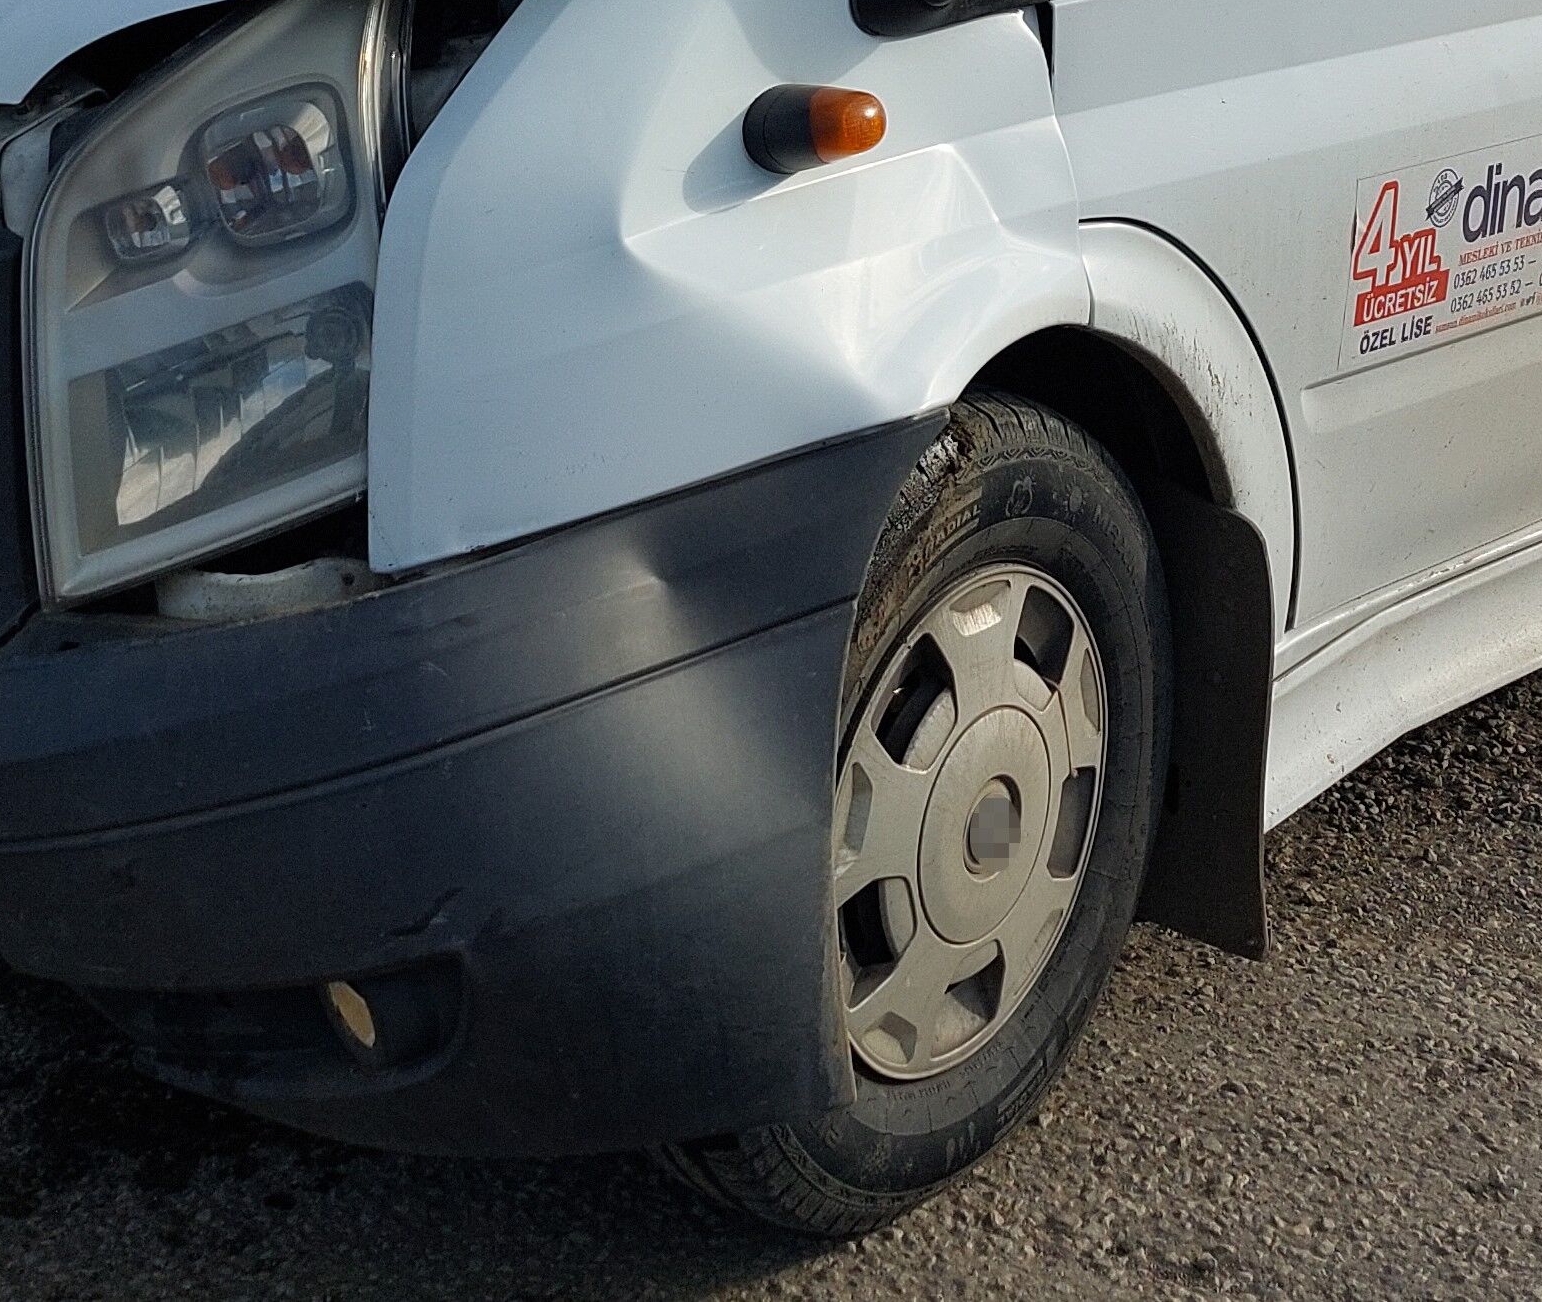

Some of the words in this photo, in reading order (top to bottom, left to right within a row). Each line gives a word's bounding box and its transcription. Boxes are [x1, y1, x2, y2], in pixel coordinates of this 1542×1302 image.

[1353, 179, 1399, 294] 4
[1397, 229, 1441, 281] YIL
[1500, 241, 1512, 254] VE
[1454, 268, 1478, 290] 0362
[1498, 258, 1511, 276] 53
[1513, 254, 1526, 272] 53
[1362, 277, 1439, 322] ÜCRETSİZ
[1450, 292, 1475, 313] 0362
[1495, 283, 1508, 301] 53
[1359, 327, 1397, 355] ÖZEL
[1400, 315, 1434, 343] LİSE
